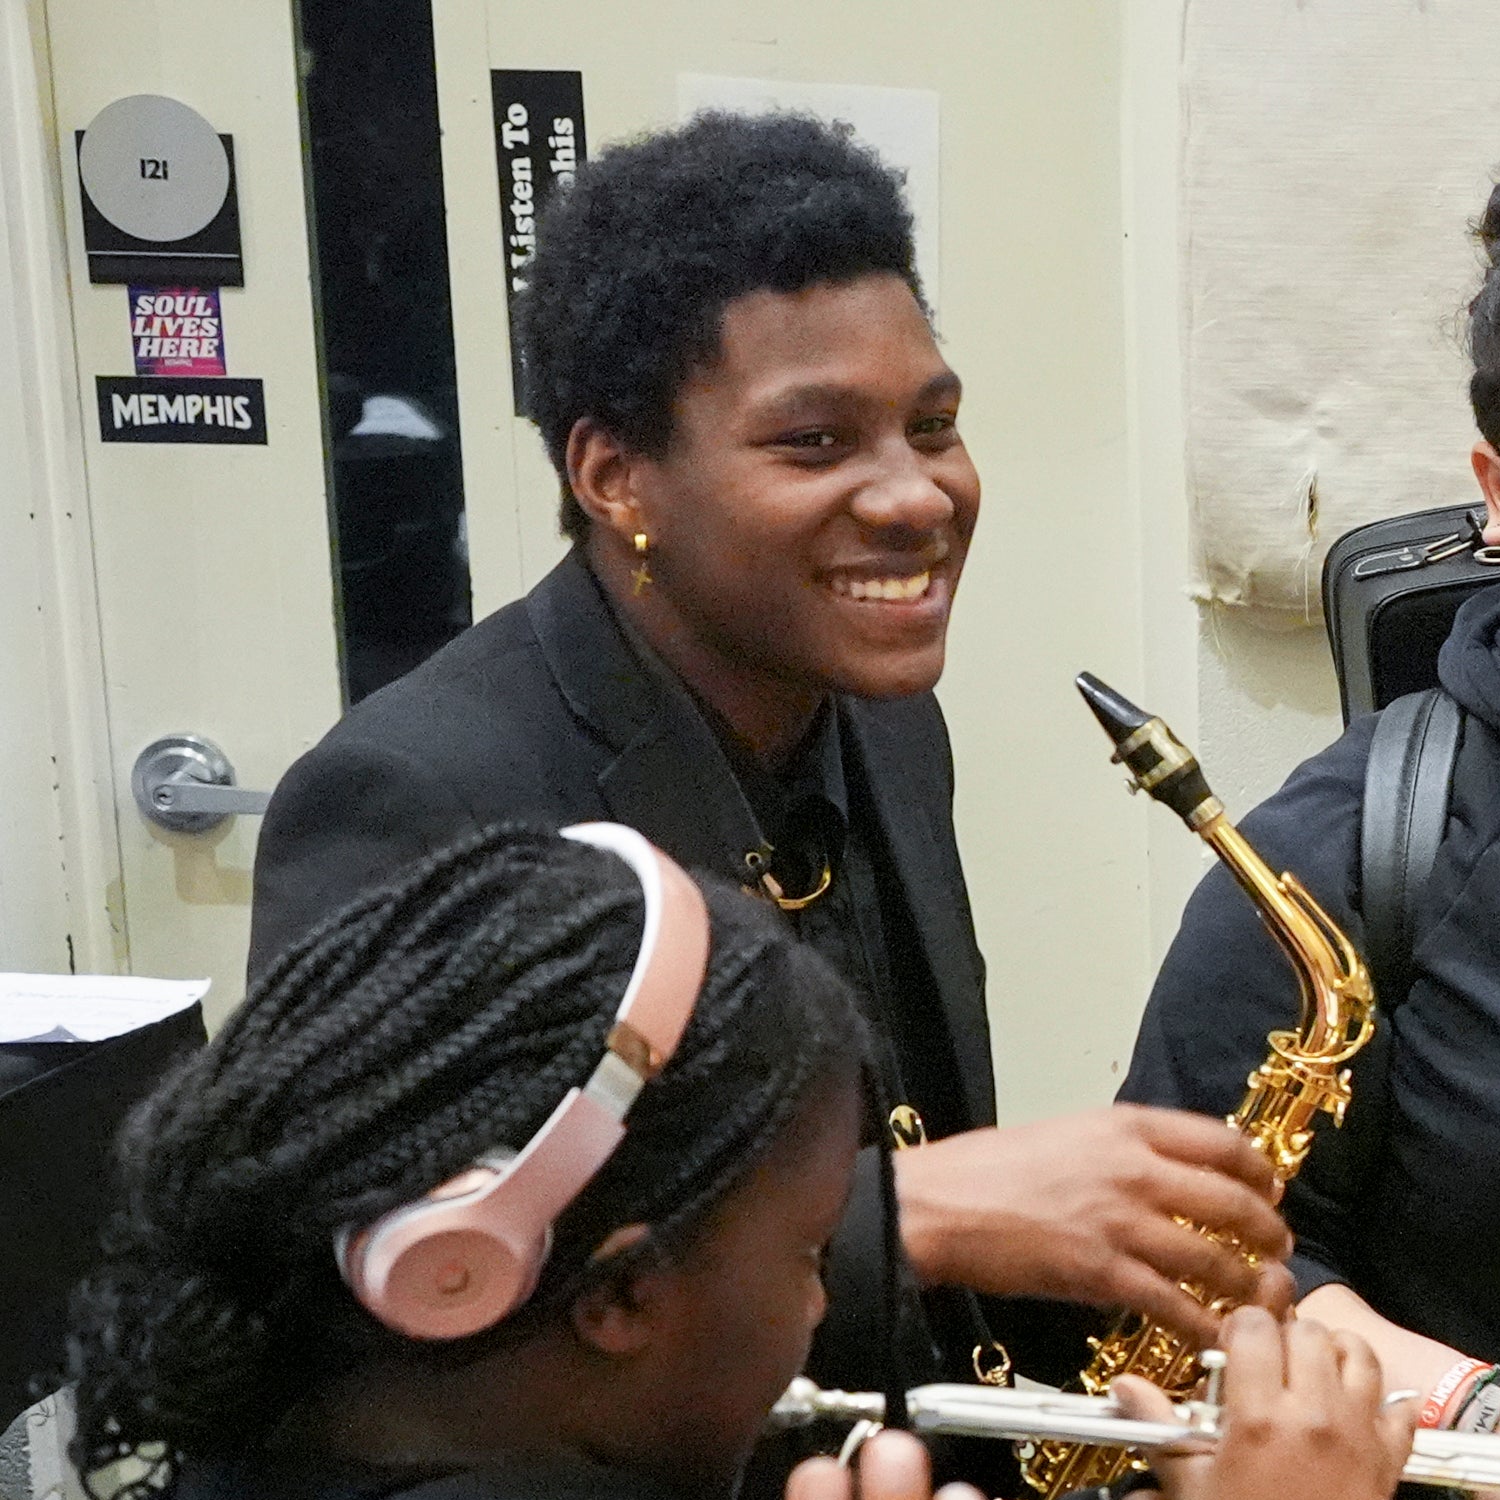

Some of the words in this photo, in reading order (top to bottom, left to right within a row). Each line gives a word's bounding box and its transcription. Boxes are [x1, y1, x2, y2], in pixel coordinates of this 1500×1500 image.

[502, 102, 530, 150] To
[135, 295, 212, 317] SOUL
[132, 316, 219, 338] LIVES
[137, 337, 219, 359] HERE
[111, 392, 252, 431] MEMPHIS
